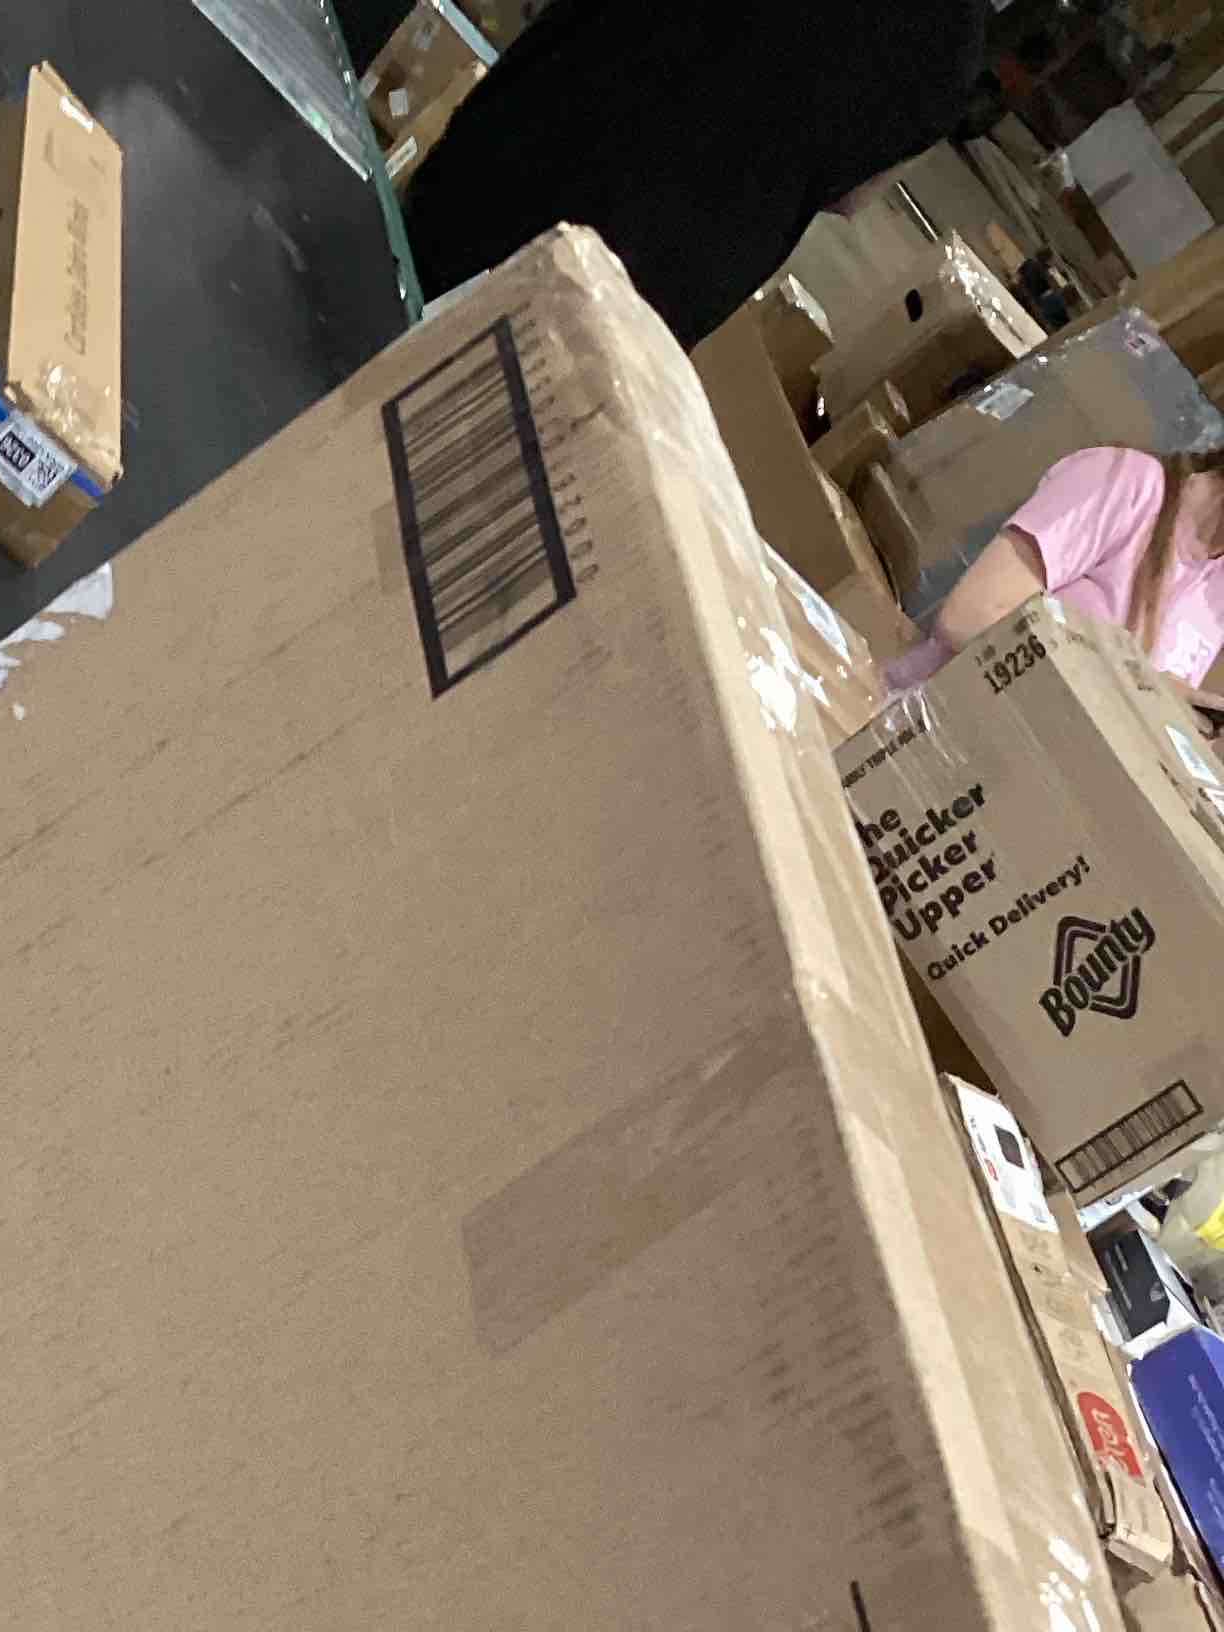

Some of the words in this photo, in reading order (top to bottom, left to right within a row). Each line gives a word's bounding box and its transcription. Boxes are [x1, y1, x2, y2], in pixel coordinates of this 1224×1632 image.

[983, 635, 1047, 694] 19236
[856, 808, 902, 848] he
[879, 829, 978, 916] Picker
[894, 857, 996, 940] Upper
[927, 931, 989, 981] Quick
[988, 856, 1090, 938] Delivery!
[1039, 908, 1155, 1038] Bounty
